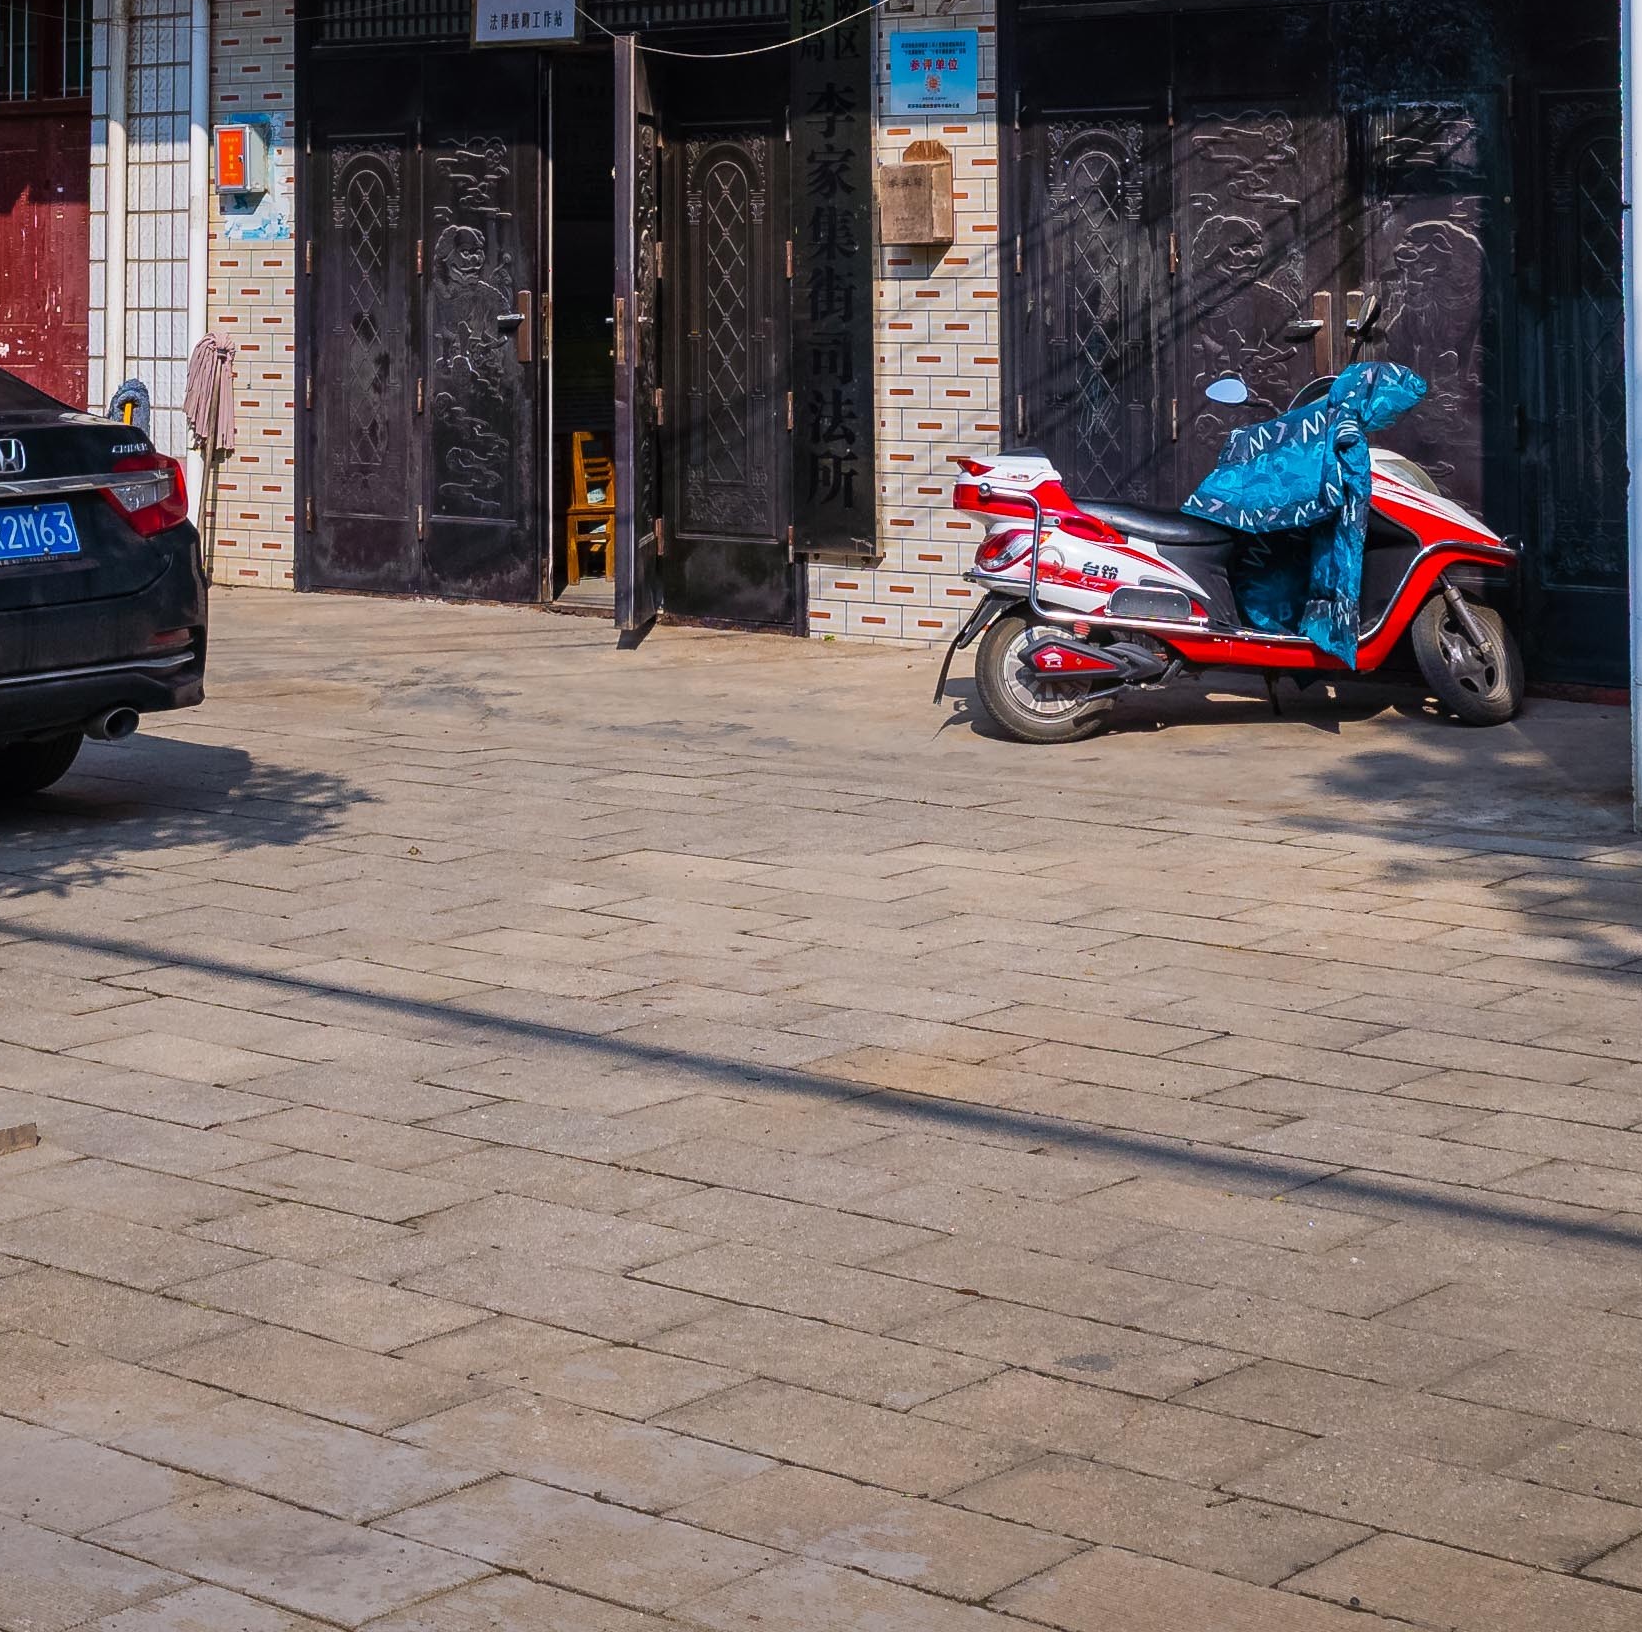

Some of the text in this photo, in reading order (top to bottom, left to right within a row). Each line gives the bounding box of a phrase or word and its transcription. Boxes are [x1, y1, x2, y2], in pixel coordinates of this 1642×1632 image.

[489, 10, 563, 30] 法律援助工作站
[910, 58, 958, 71] 参评单位
[806, 82, 858, 508] 李家集街司法所
[1082, 561, 1119, 580] 台铃
